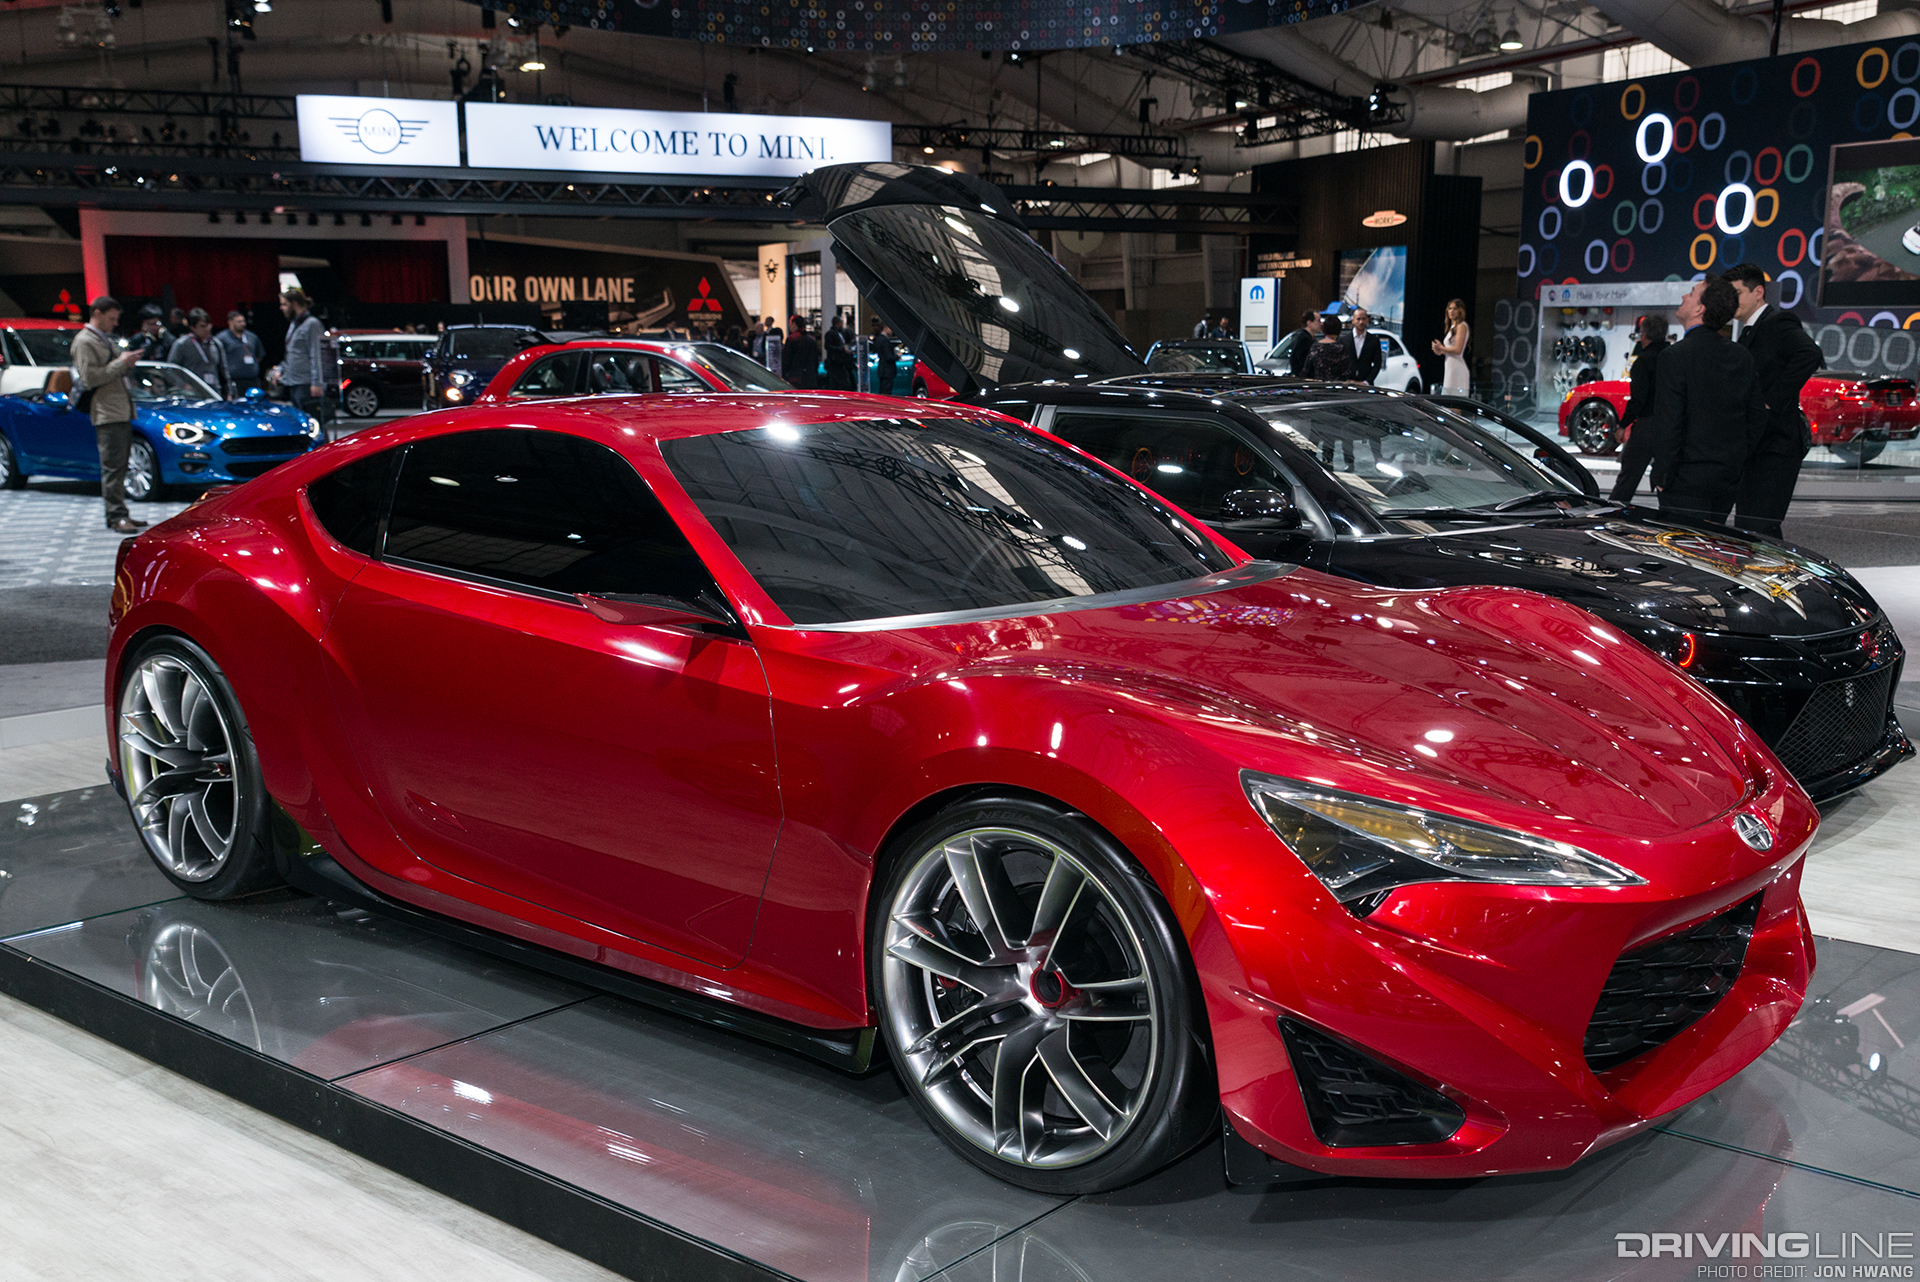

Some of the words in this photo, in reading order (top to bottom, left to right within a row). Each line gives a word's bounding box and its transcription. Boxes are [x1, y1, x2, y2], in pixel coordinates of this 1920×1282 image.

[363, 125, 397, 137] MINI
[533, 124, 699, 156] WELCOME
[708, 132, 748, 158] TO
[758, 134, 835, 160] MINI.
[470, 274, 518, 302] OUR
[524, 276, 575, 303] OWN
[582, 277, 636, 303] LANE
